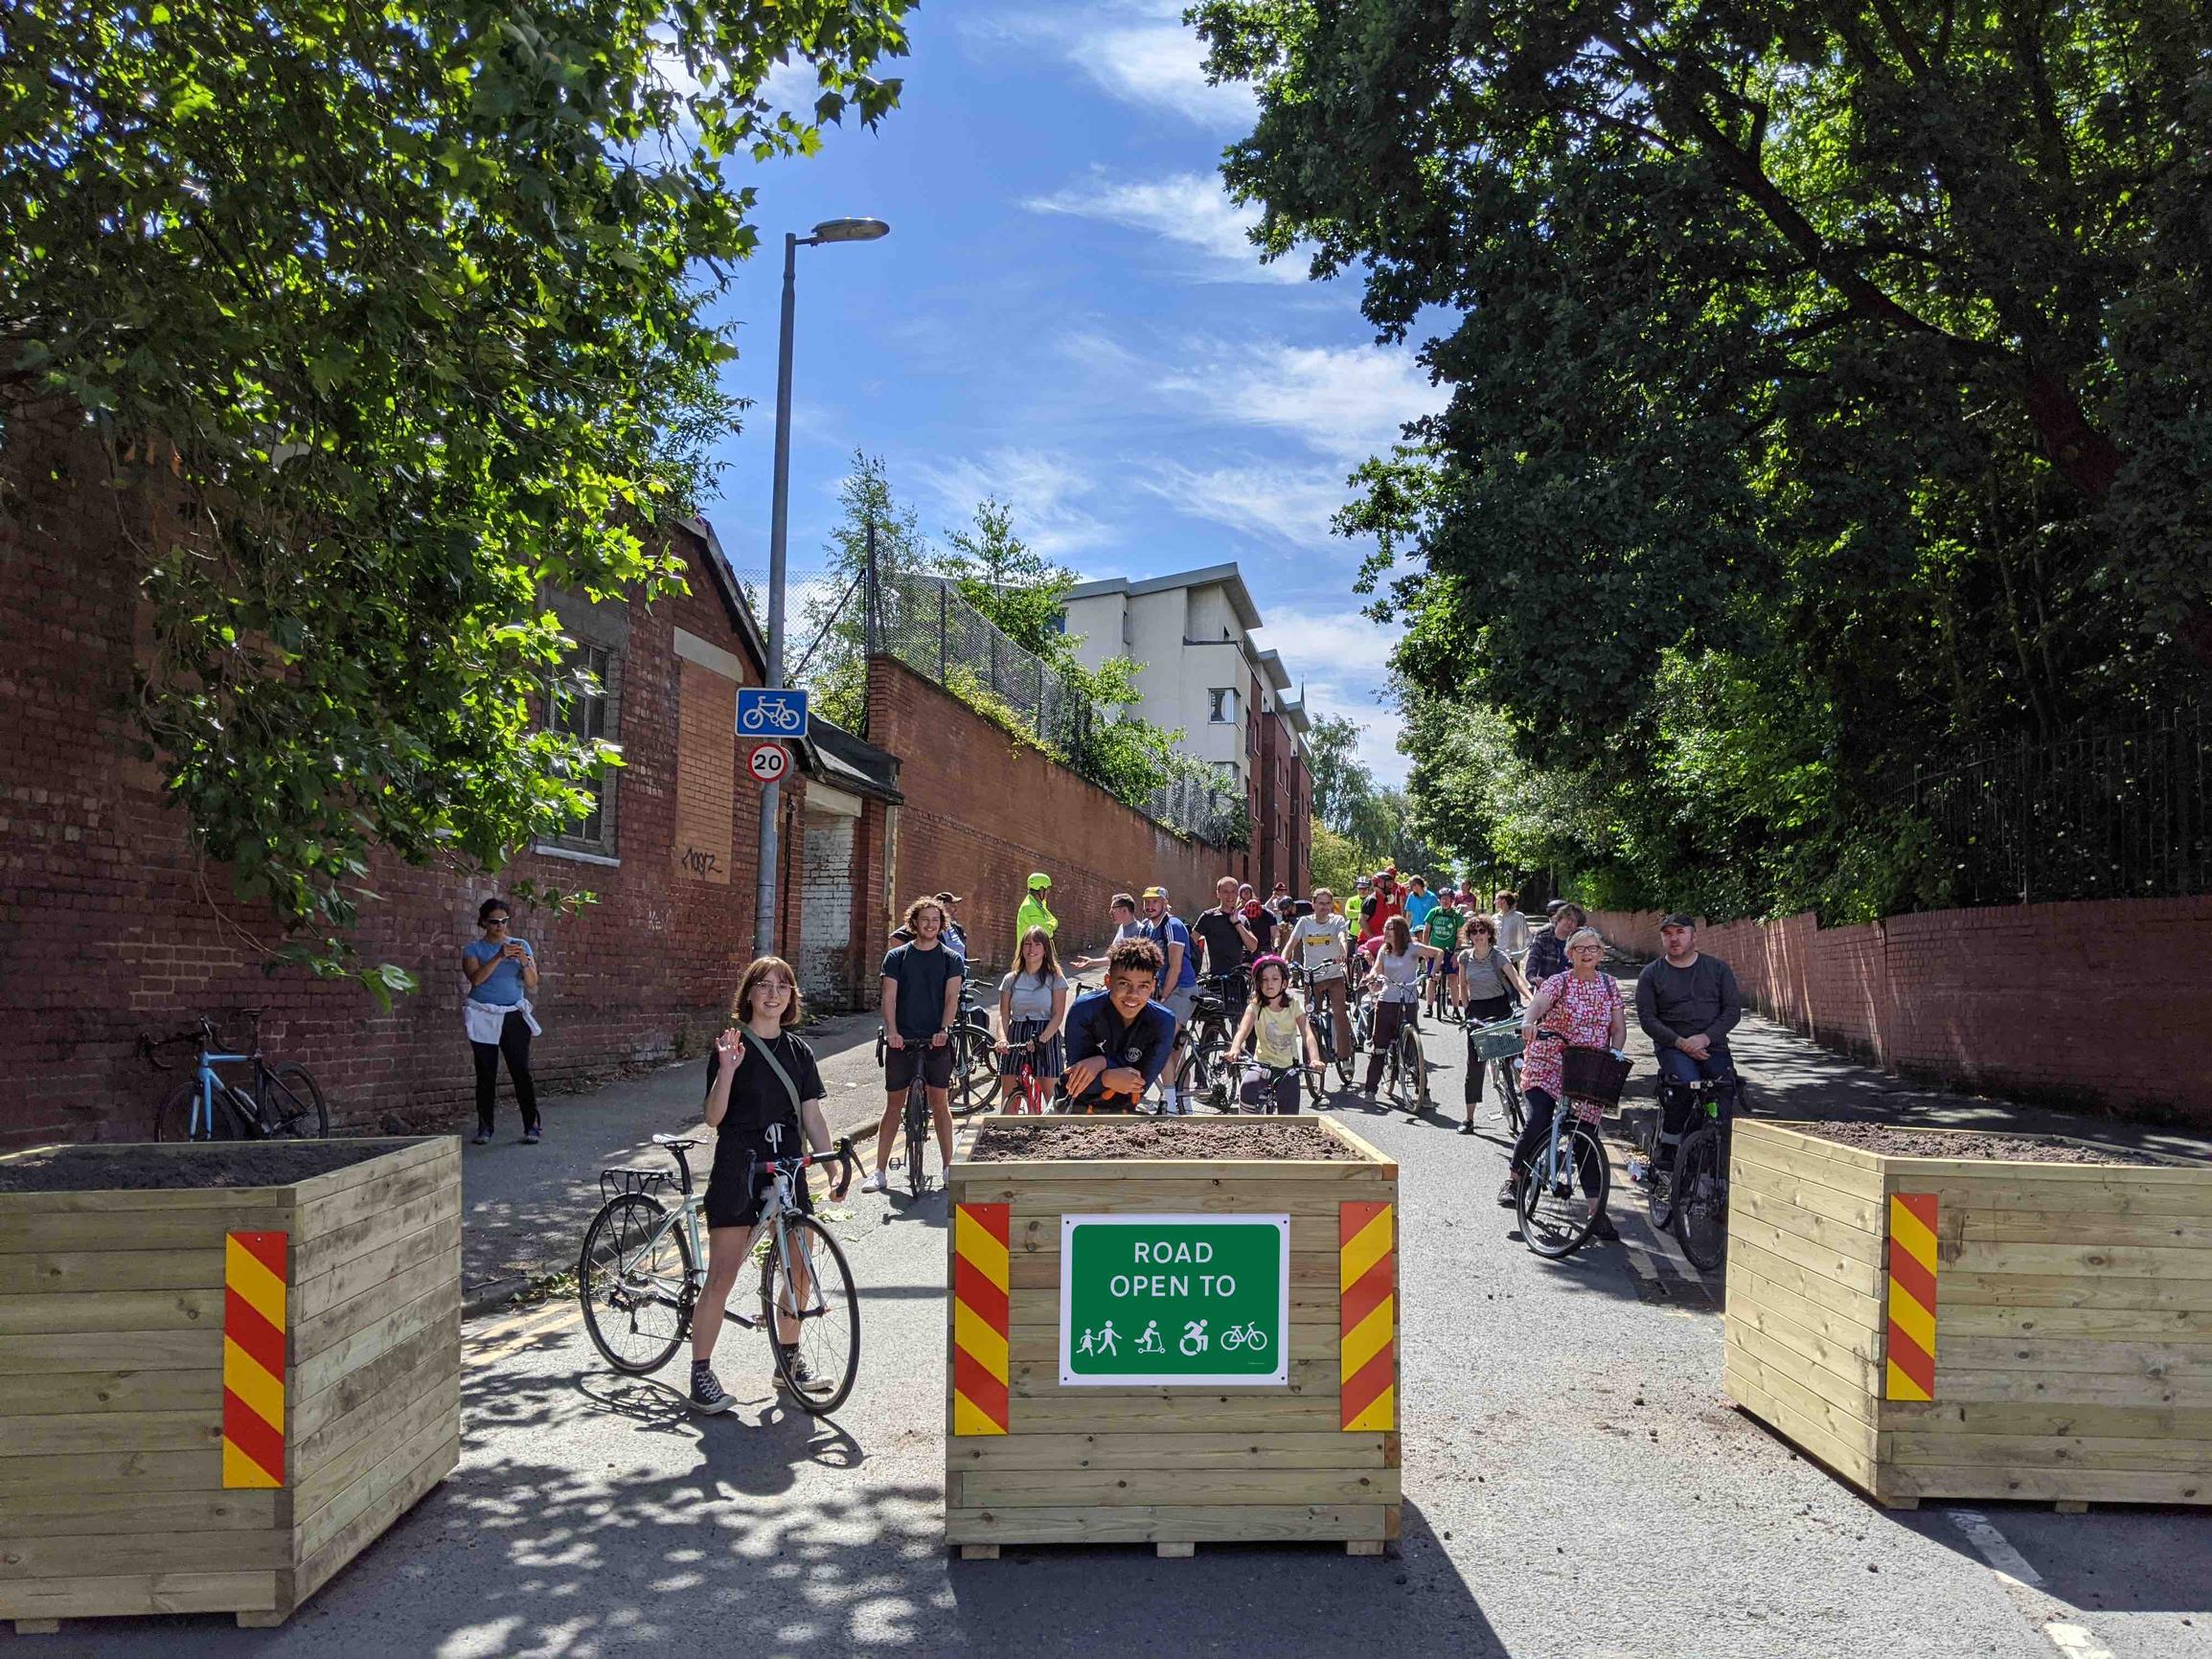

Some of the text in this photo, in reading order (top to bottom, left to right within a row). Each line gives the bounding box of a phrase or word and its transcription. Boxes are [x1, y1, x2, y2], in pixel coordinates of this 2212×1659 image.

[754, 754, 782, 771] 20
[1133, 1241, 1214, 1263] ROAD
[1109, 1275, 1236, 1297] OPEN TO
